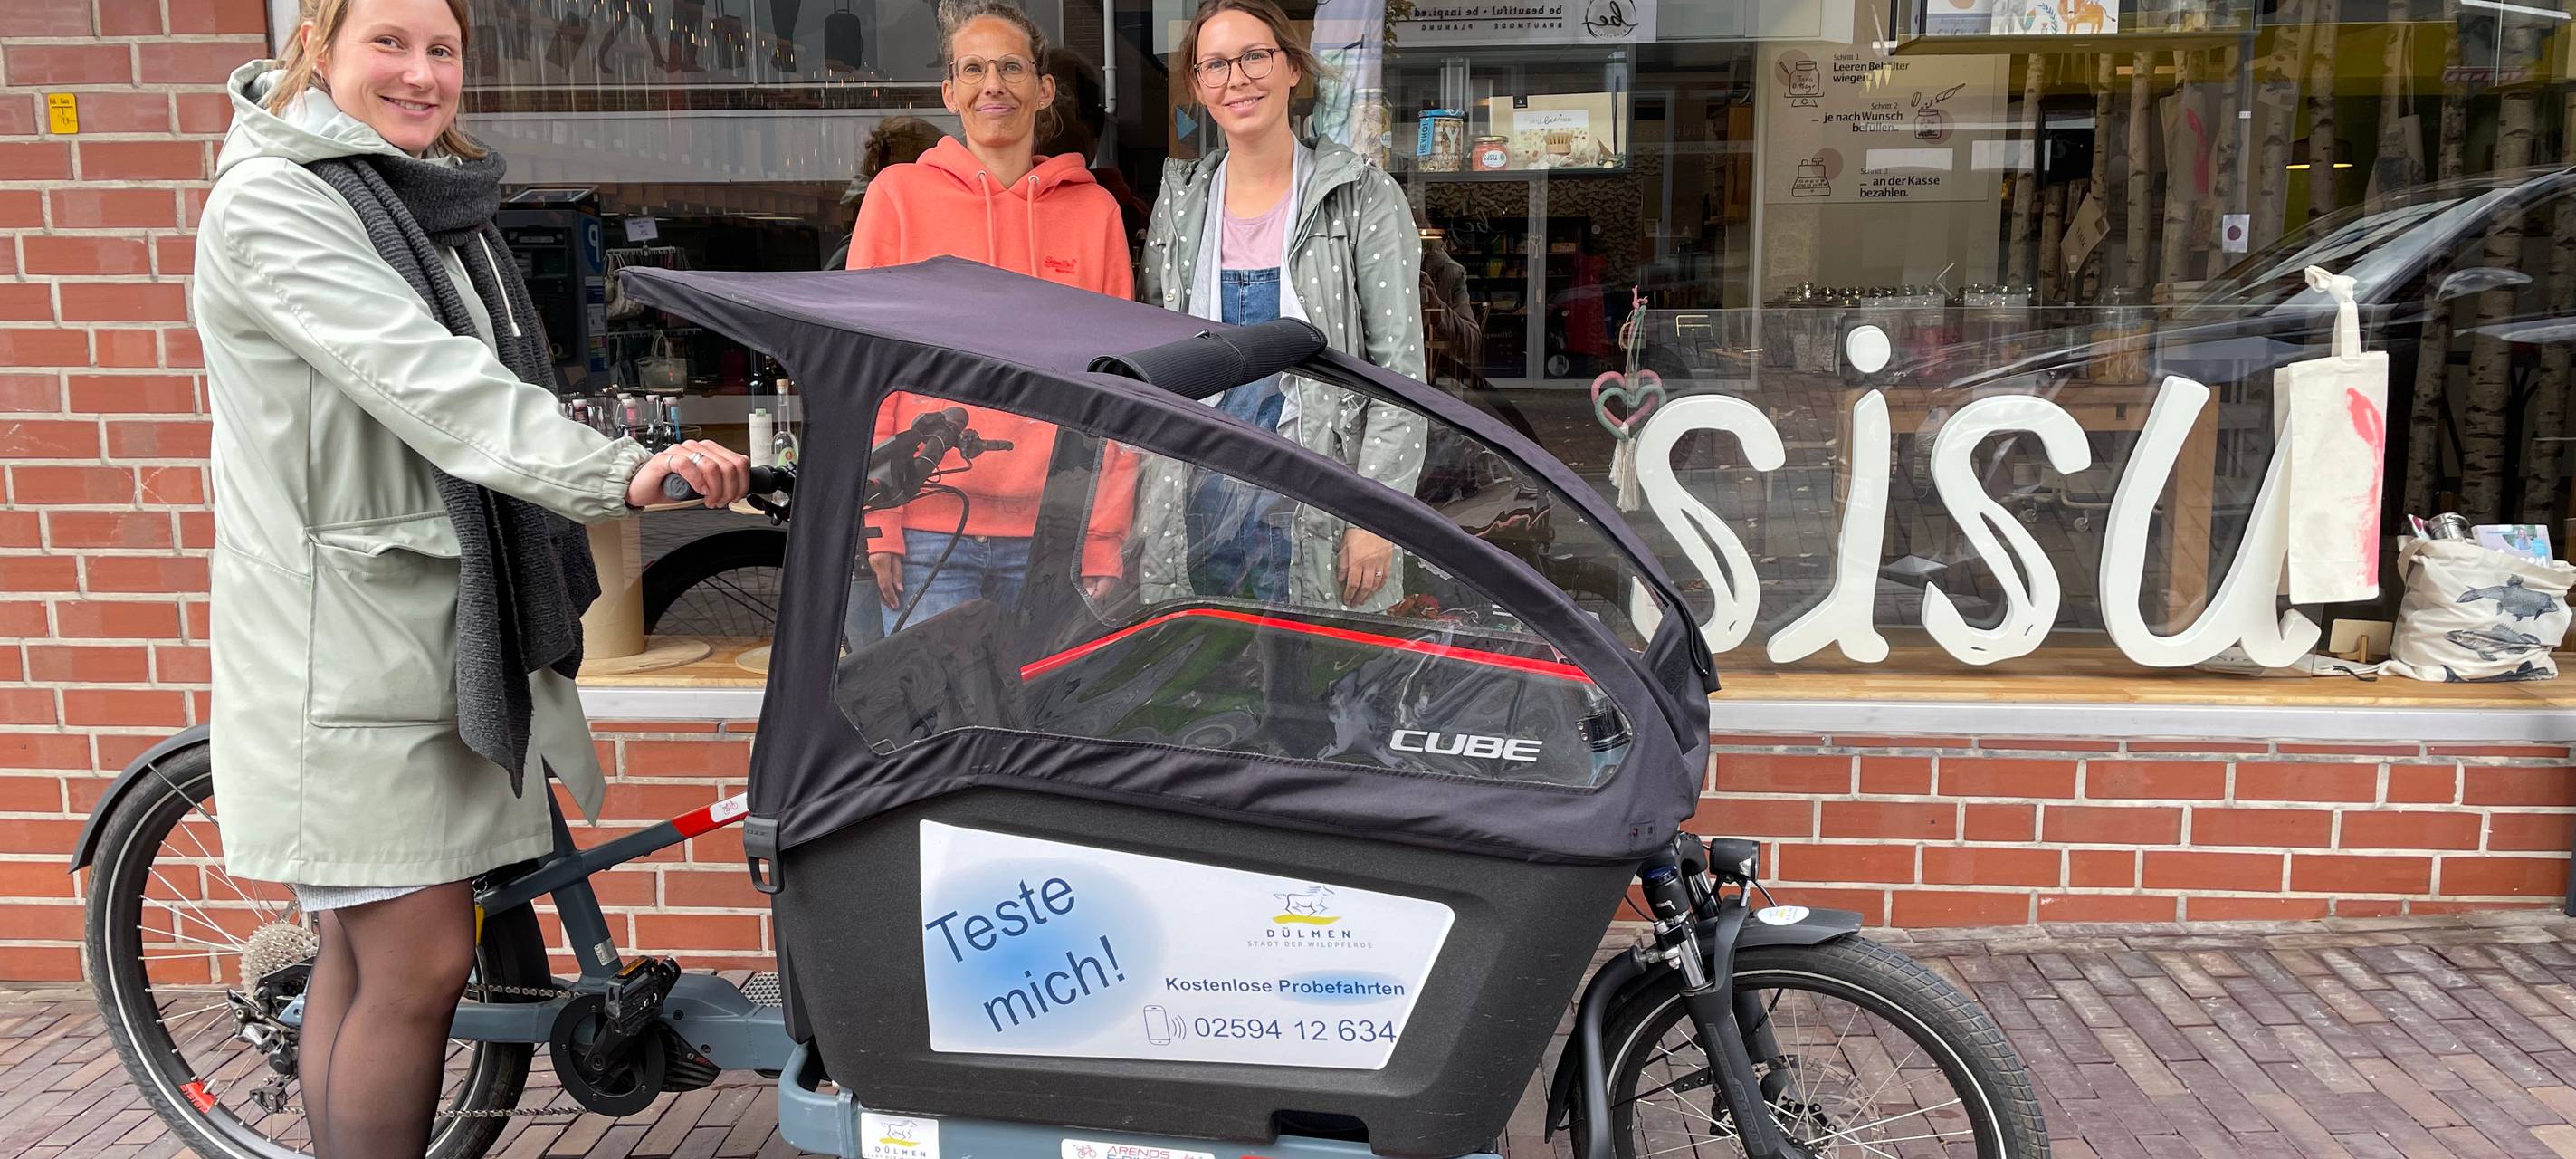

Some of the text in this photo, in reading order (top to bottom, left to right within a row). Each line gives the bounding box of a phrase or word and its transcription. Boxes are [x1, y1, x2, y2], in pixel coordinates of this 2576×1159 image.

[1833, 62, 1867, 72] Leeren
[1823, 110, 1903, 123] je nach Wunsch
[1872, 176, 1941, 186] an der Kasse
[1632, 324, 2322, 668] sisu
[1389, 729, 1543, 762] CUBE
[925, 877, 1075, 963] Teste
[1266, 927, 1351, 939] DÜLMEN
[1247, 940, 1279, 948] STADT
[1308, 941, 1373, 949] WILDPFERDE
[983, 934, 1125, 1033] mich!
[1165, 977, 1405, 996] Kostenlose Probefahrten
[1194, 1017, 1397, 1043] 02594 12 634
[874, 1145, 927, 1158] DÜLMEN
